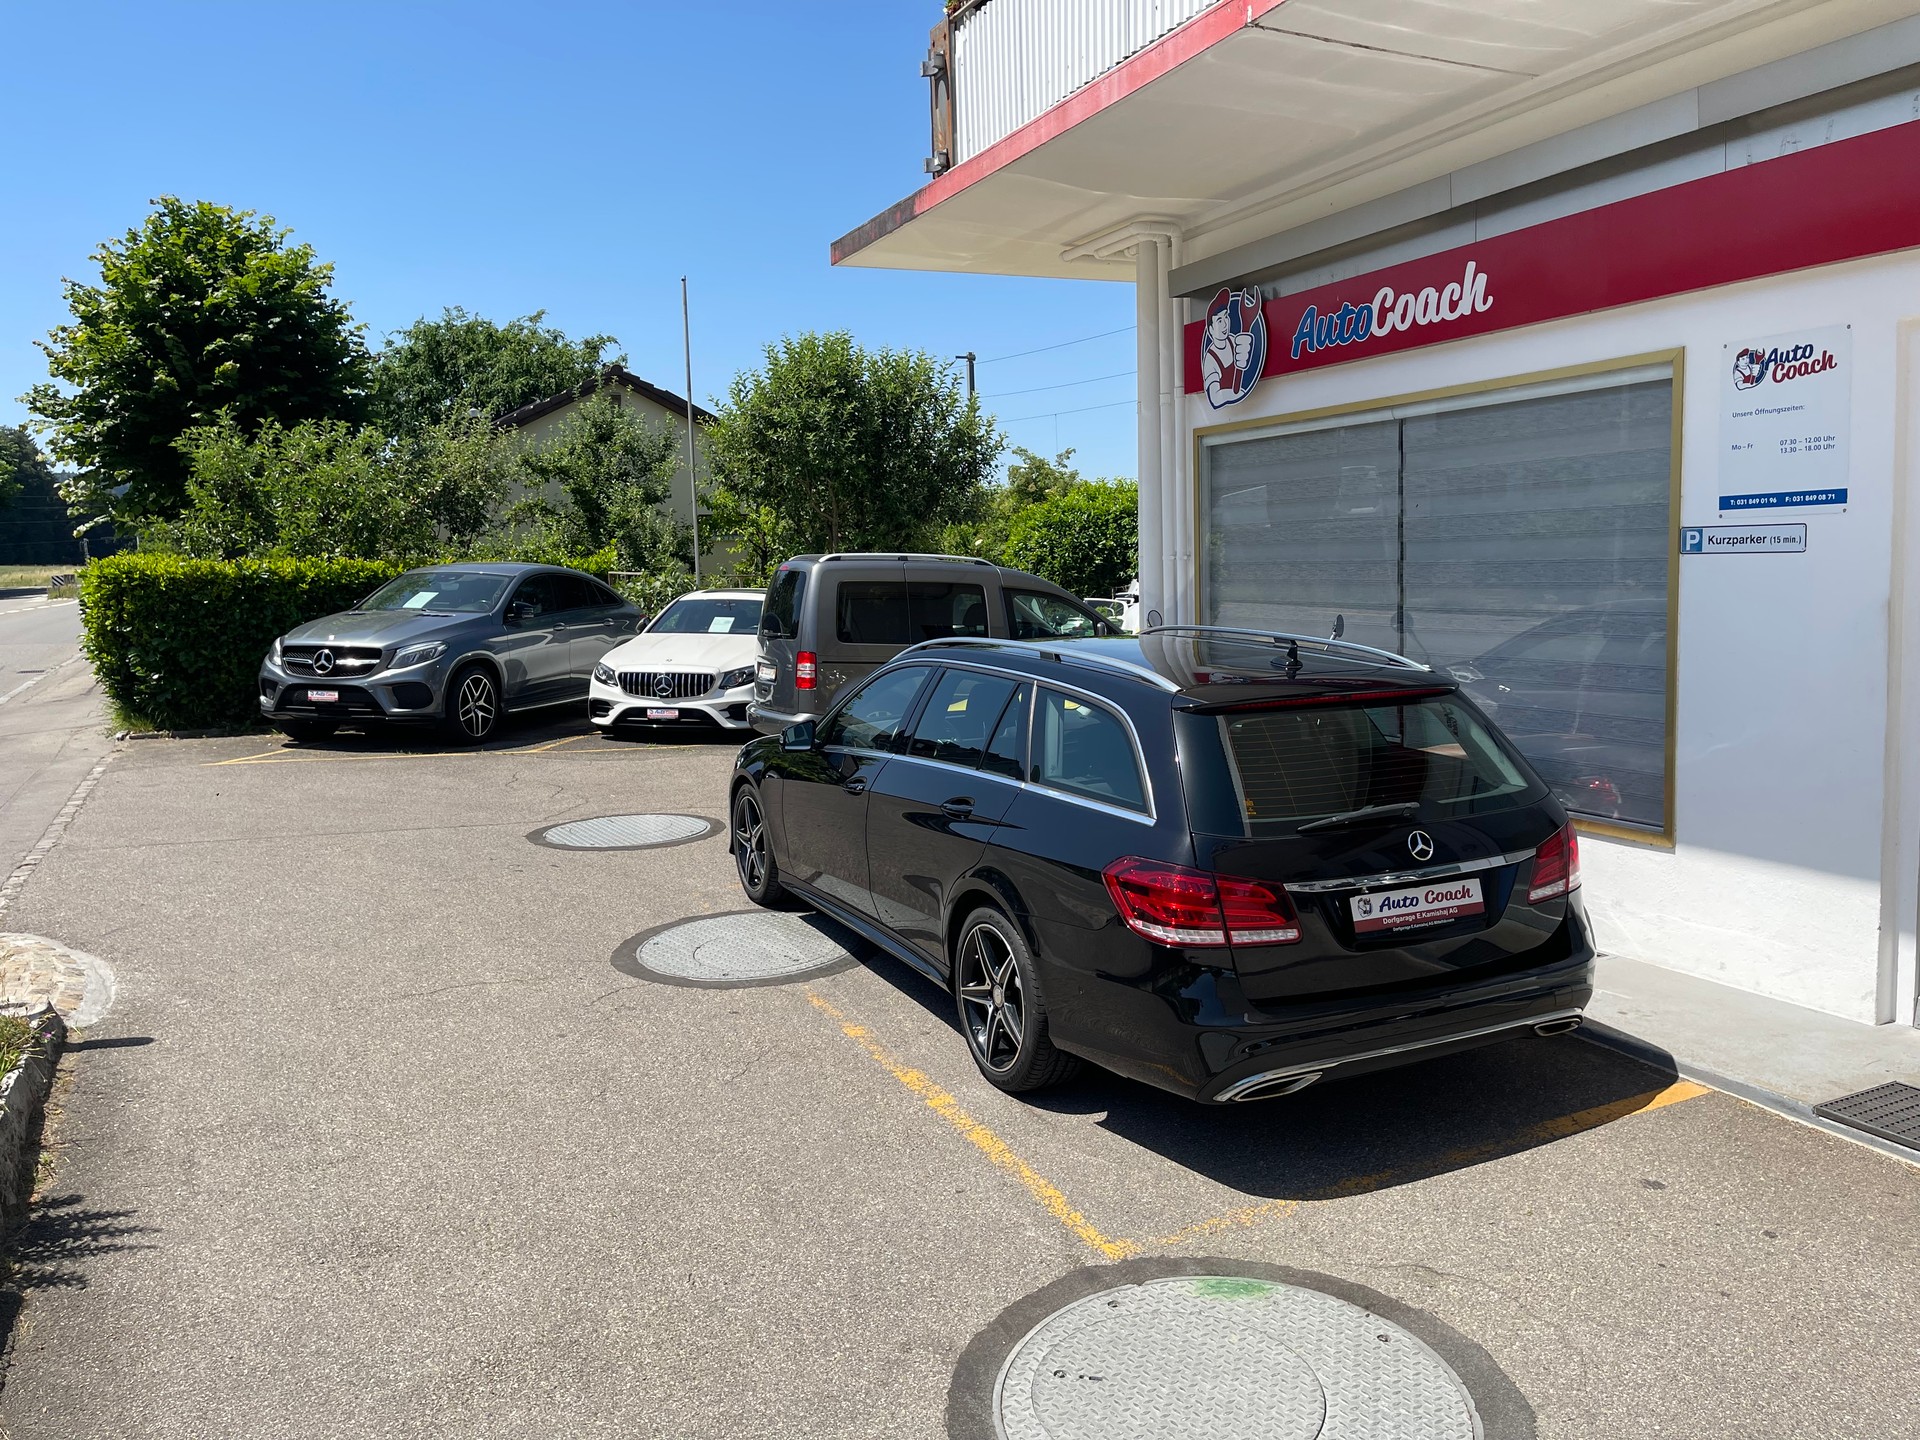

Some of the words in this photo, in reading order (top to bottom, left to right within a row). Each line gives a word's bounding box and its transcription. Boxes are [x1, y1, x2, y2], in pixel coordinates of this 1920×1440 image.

[1765, 344, 1813, 371] Auto
[1772, 350, 1837, 383] Coach
[1754, 405, 1805, 415] Öffnungszeiten:
[1780, 438, 1797, 446] 07.30
[1780, 446, 1797, 454] 13.30
[1685, 531, 1700, 551] P
[1707, 534, 1767, 547] Kurzparker
[1769, 536, 1781, 545] (15
[1782, 535, 1802, 545] min.)
[1379, 895, 1419, 912] Auto
[1424, 885, 1473, 904] Coach
[1383, 914, 1416, 924] Dorfgarage
